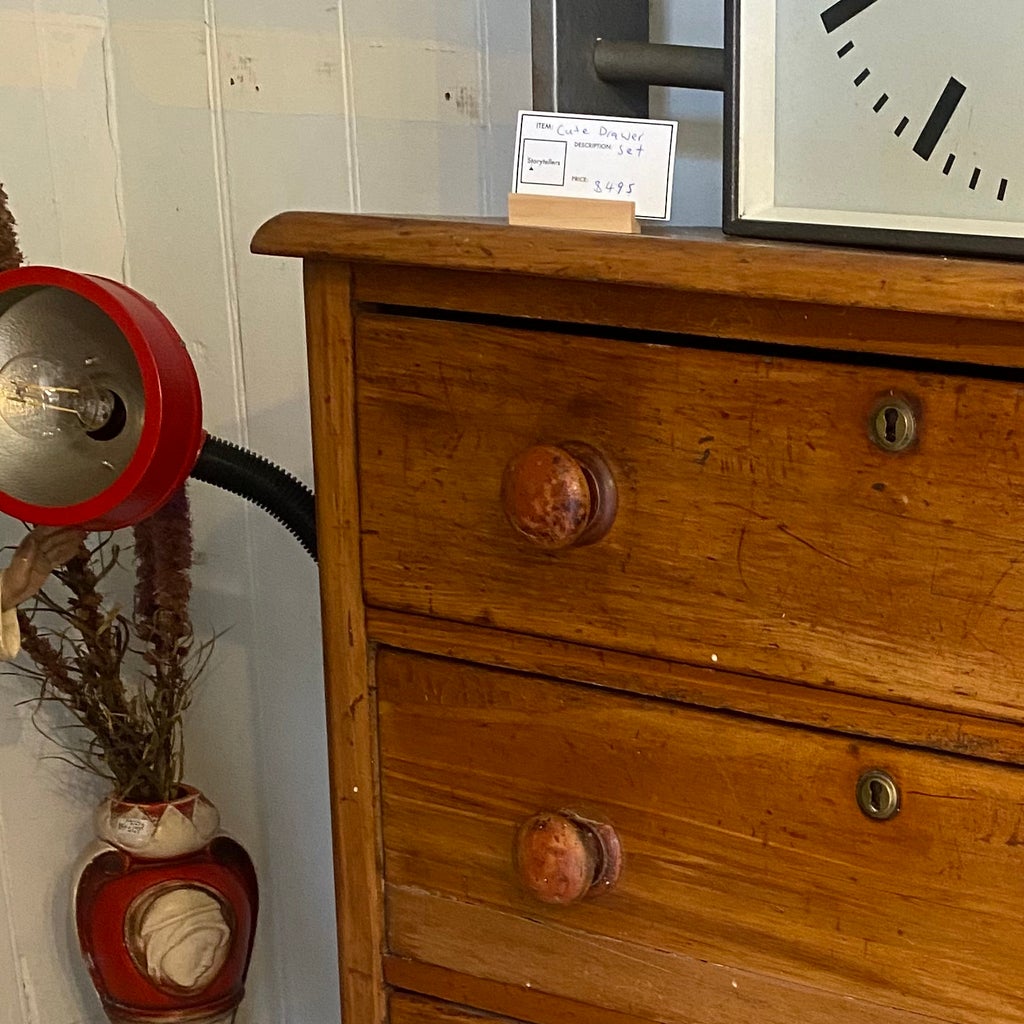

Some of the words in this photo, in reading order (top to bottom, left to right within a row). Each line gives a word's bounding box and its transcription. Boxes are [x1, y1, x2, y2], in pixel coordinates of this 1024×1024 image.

[557, 124, 590, 136] Cute
[599, 126, 645, 141] Drawer
[574, 142, 612, 150] DESCRIPTION:
[618, 145, 645, 157] Set
[527, 158, 560, 166] Storytellers
[594, 181, 635, 194] $495
